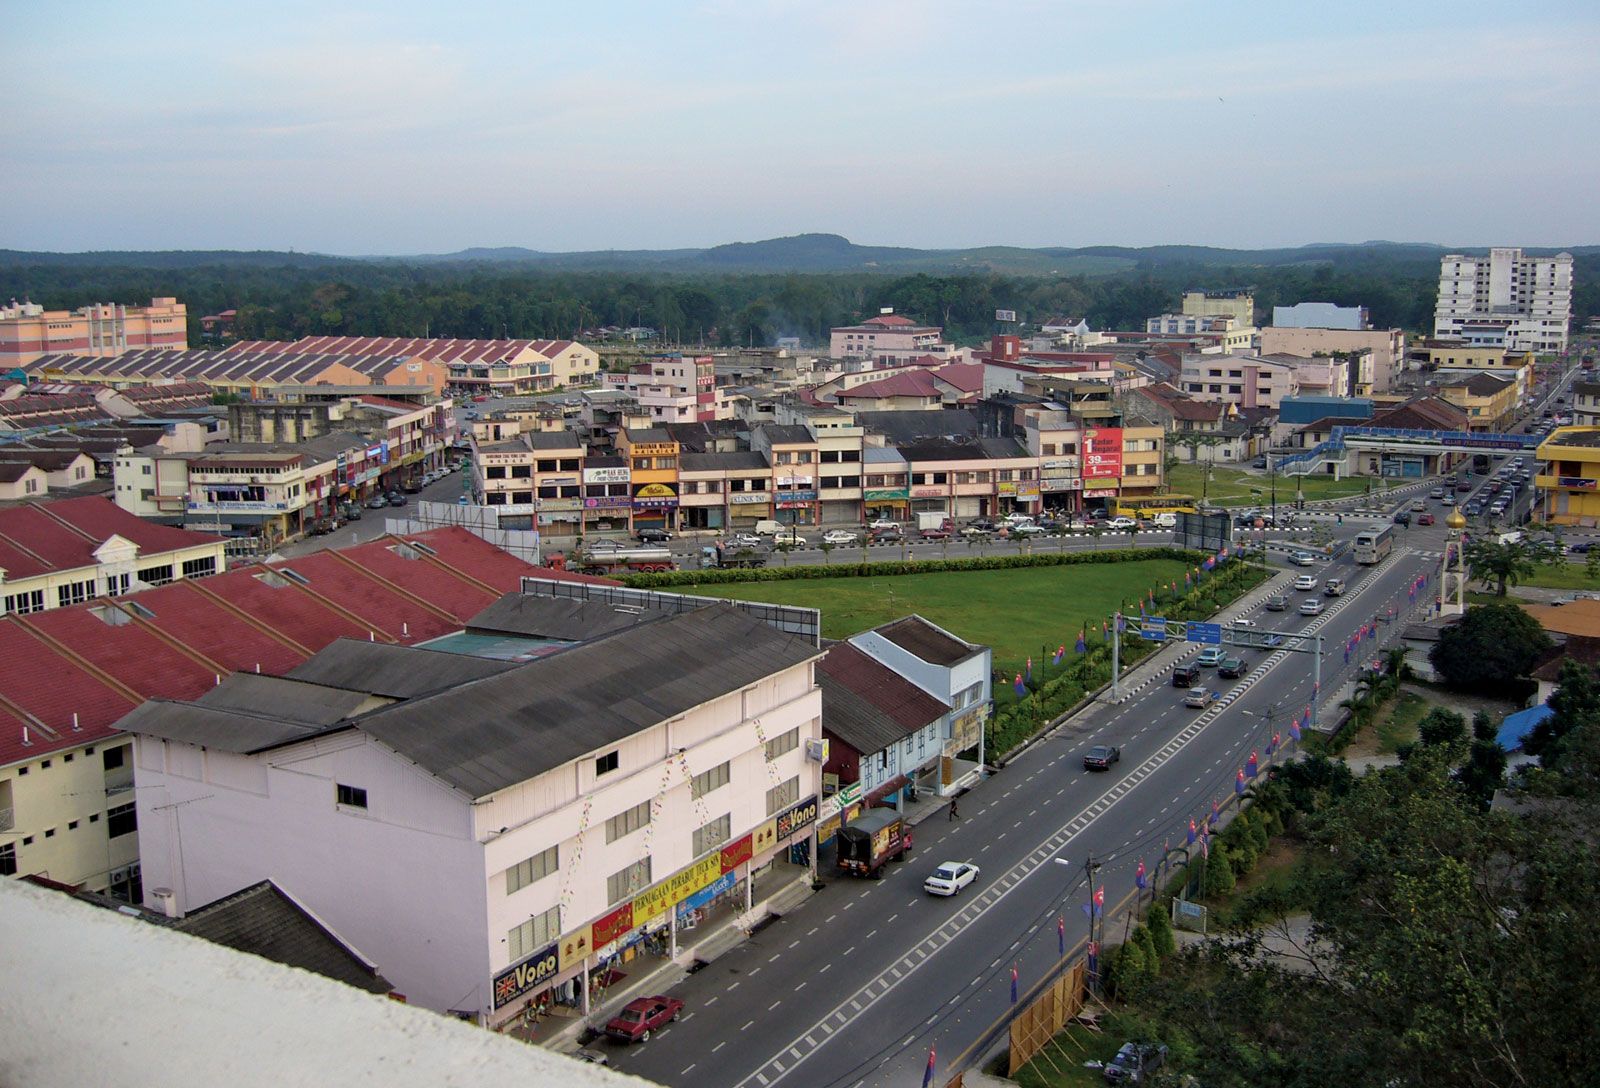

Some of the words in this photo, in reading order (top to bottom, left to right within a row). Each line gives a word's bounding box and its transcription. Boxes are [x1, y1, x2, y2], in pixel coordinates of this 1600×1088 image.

[1085, 439, 1092, 453] 1
[1088, 456, 1101, 464] 39
[789, 803, 816, 827] Vono
[515, 956, 556, 988] Vono
